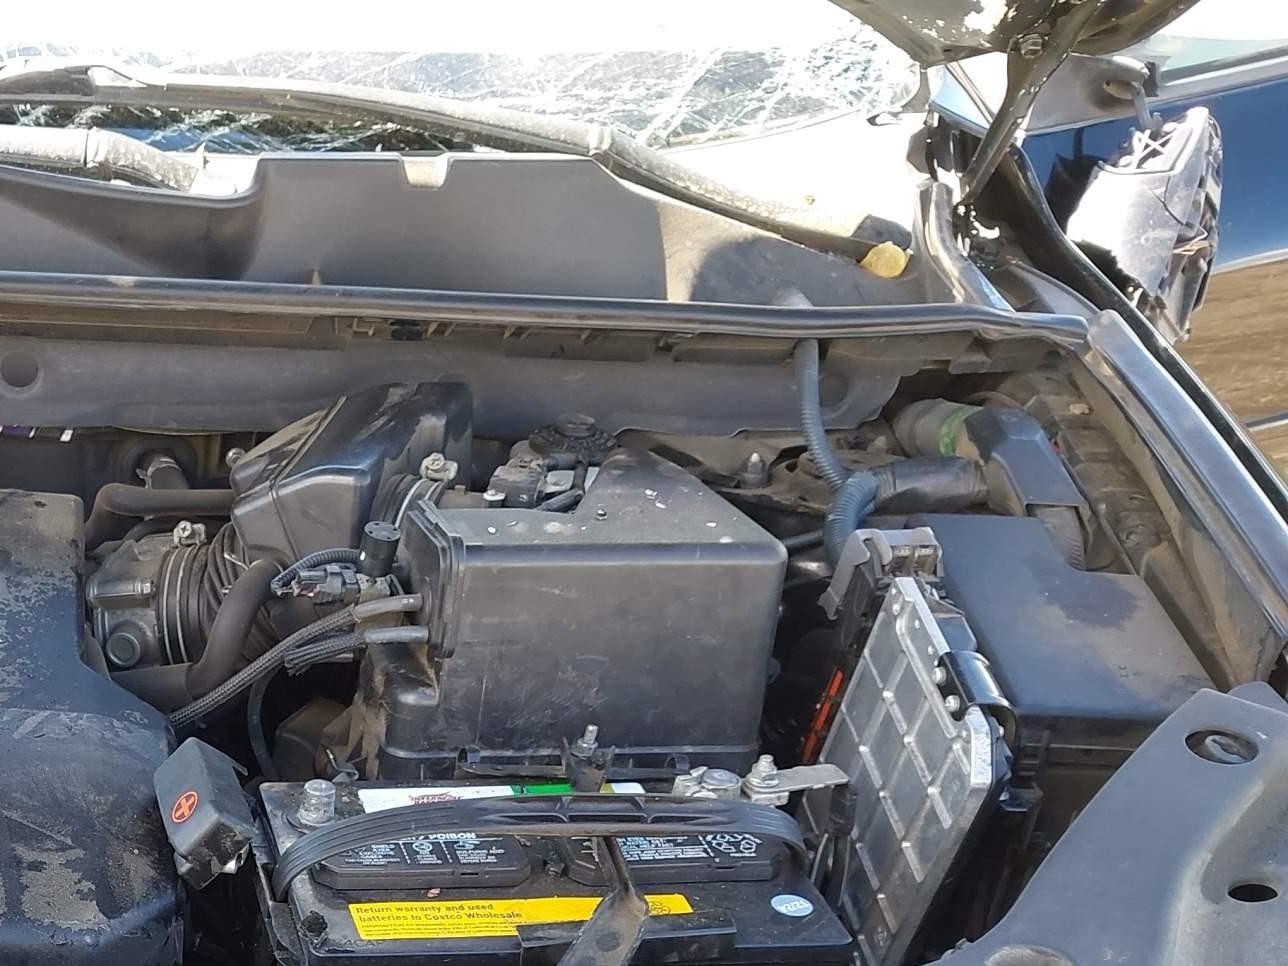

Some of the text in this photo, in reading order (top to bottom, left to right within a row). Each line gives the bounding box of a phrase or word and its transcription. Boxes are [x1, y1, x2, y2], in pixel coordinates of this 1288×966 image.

[395, 905, 441, 913] warranty
[445, 904, 465, 912] and
[467, 903, 494, 911] used
[359, 914, 409, 923] batteries
[424, 913, 463, 921] Costco
[465, 911, 522, 919] Wholesale
